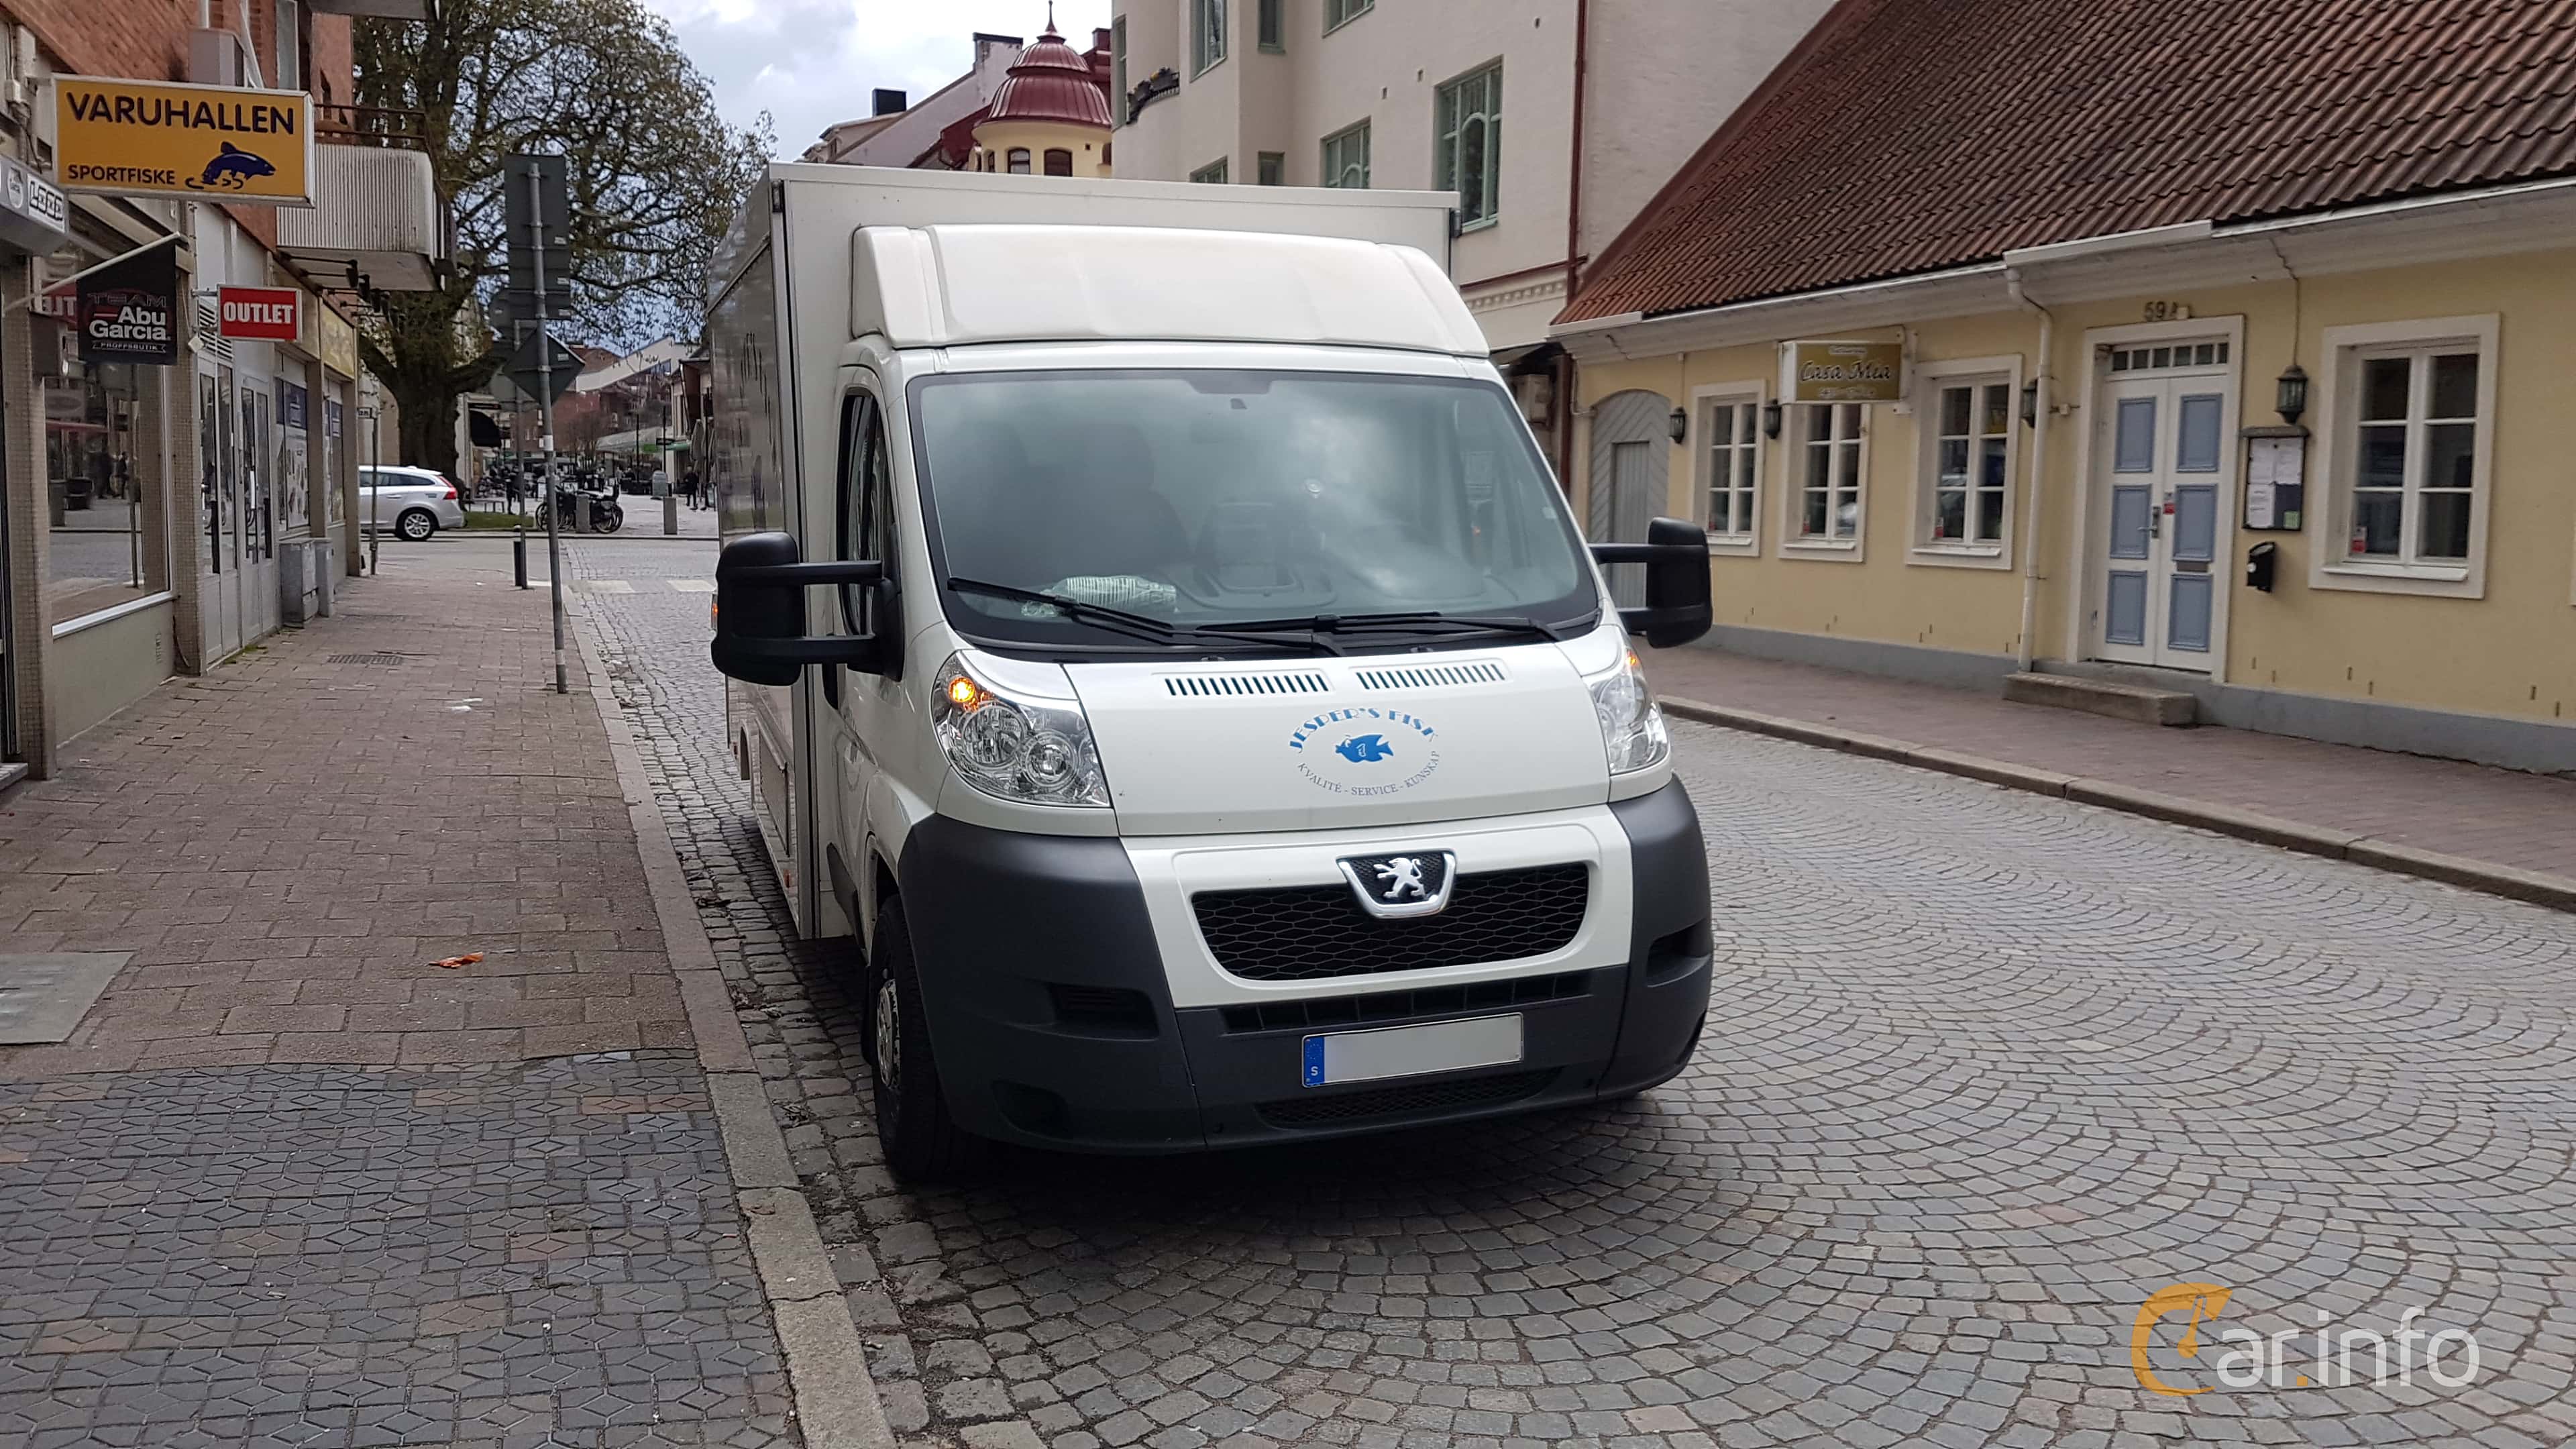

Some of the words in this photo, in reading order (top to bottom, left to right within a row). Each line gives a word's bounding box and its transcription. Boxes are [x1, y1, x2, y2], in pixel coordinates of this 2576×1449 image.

[66, 92, 294, 135] VARUHALLEN
[68, 164, 176, 185] SPORTFISKE
[87, 292, 167, 308] TEAM
[118, 306, 166, 325] Abu
[223, 302, 293, 324] OUTLET
[89, 319, 167, 341] Garcia
[1297, 762, 1342, 794] KVALITÉ
[1351, 784, 1399, 796] SERVICE
[1404, 751, 1441, 789] KUNSKAP
[1310, 1066, 1319, 1077] S
